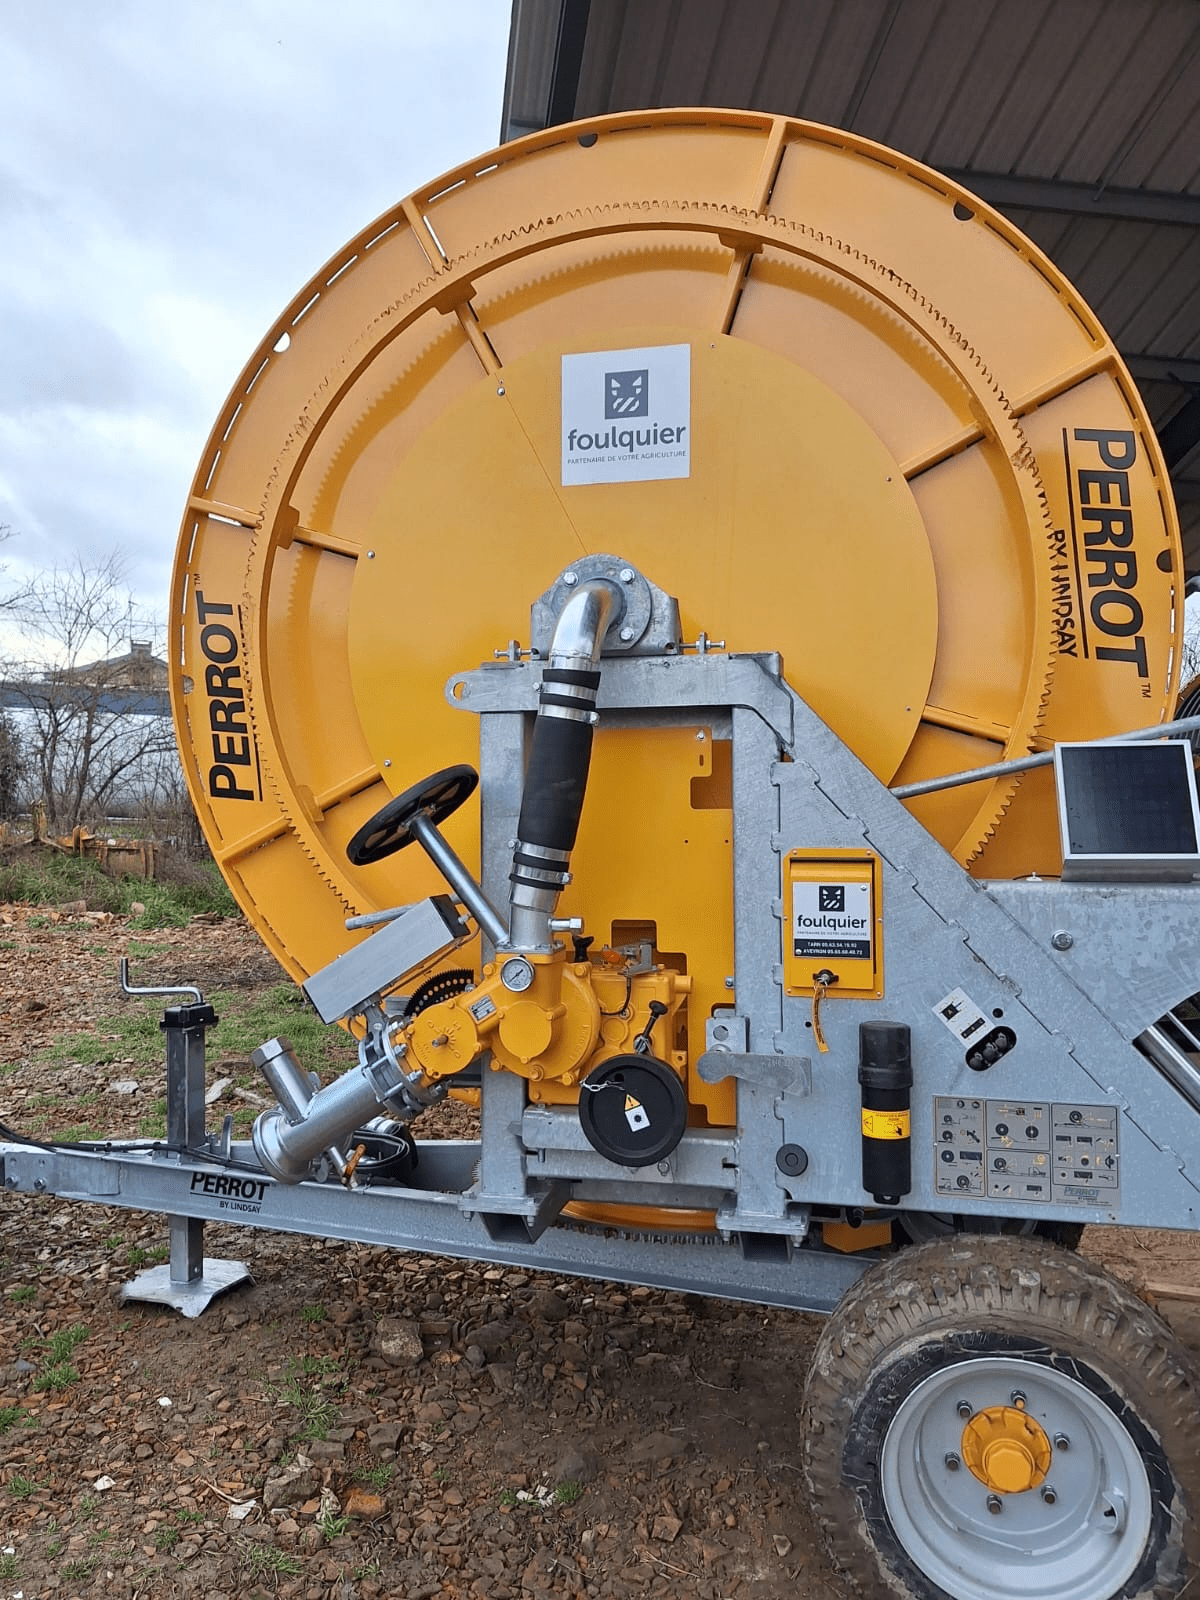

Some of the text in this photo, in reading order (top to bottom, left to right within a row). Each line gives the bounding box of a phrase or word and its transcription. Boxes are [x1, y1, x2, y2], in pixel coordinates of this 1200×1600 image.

[567, 422, 687, 453] foulquier
[567, 456, 605, 465] PARTENAIRE
[617, 453, 640, 461] VOTRE
[640, 450, 687, 459] AGRICULTURE
[1074, 428, 1149, 678] PERROT
[195, 590, 255, 801] PERROT
[797, 914, 867, 931] foulquier
[190, 1172, 270, 1201] PERROT
[219, 1201, 262, 1214] BY LINDSAY
